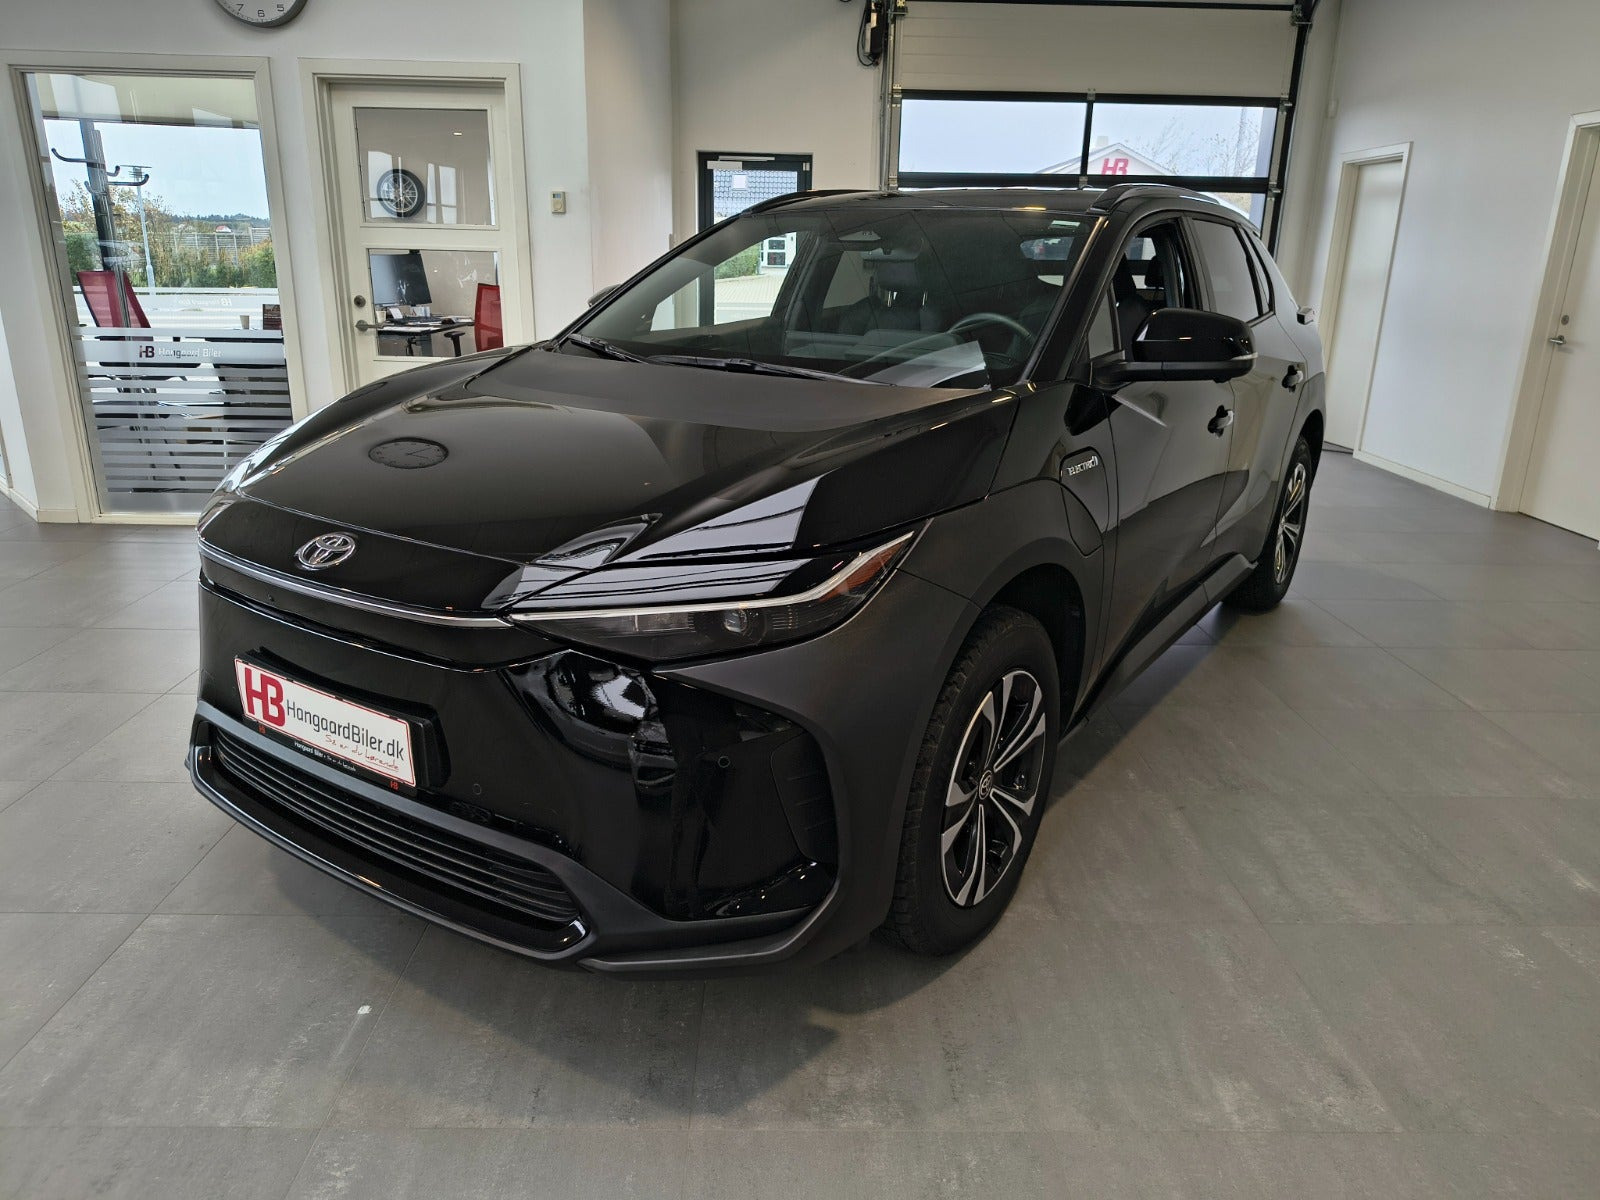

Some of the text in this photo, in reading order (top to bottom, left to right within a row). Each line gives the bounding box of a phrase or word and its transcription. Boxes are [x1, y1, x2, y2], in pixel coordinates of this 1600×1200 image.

[257, 10, 265, 18] 6
[276, 4, 285, 12] 5
[139, 345, 155, 359] HB
[244, 666, 286, 727] HB
[286, 699, 405, 761] HangaardBiler.dk
